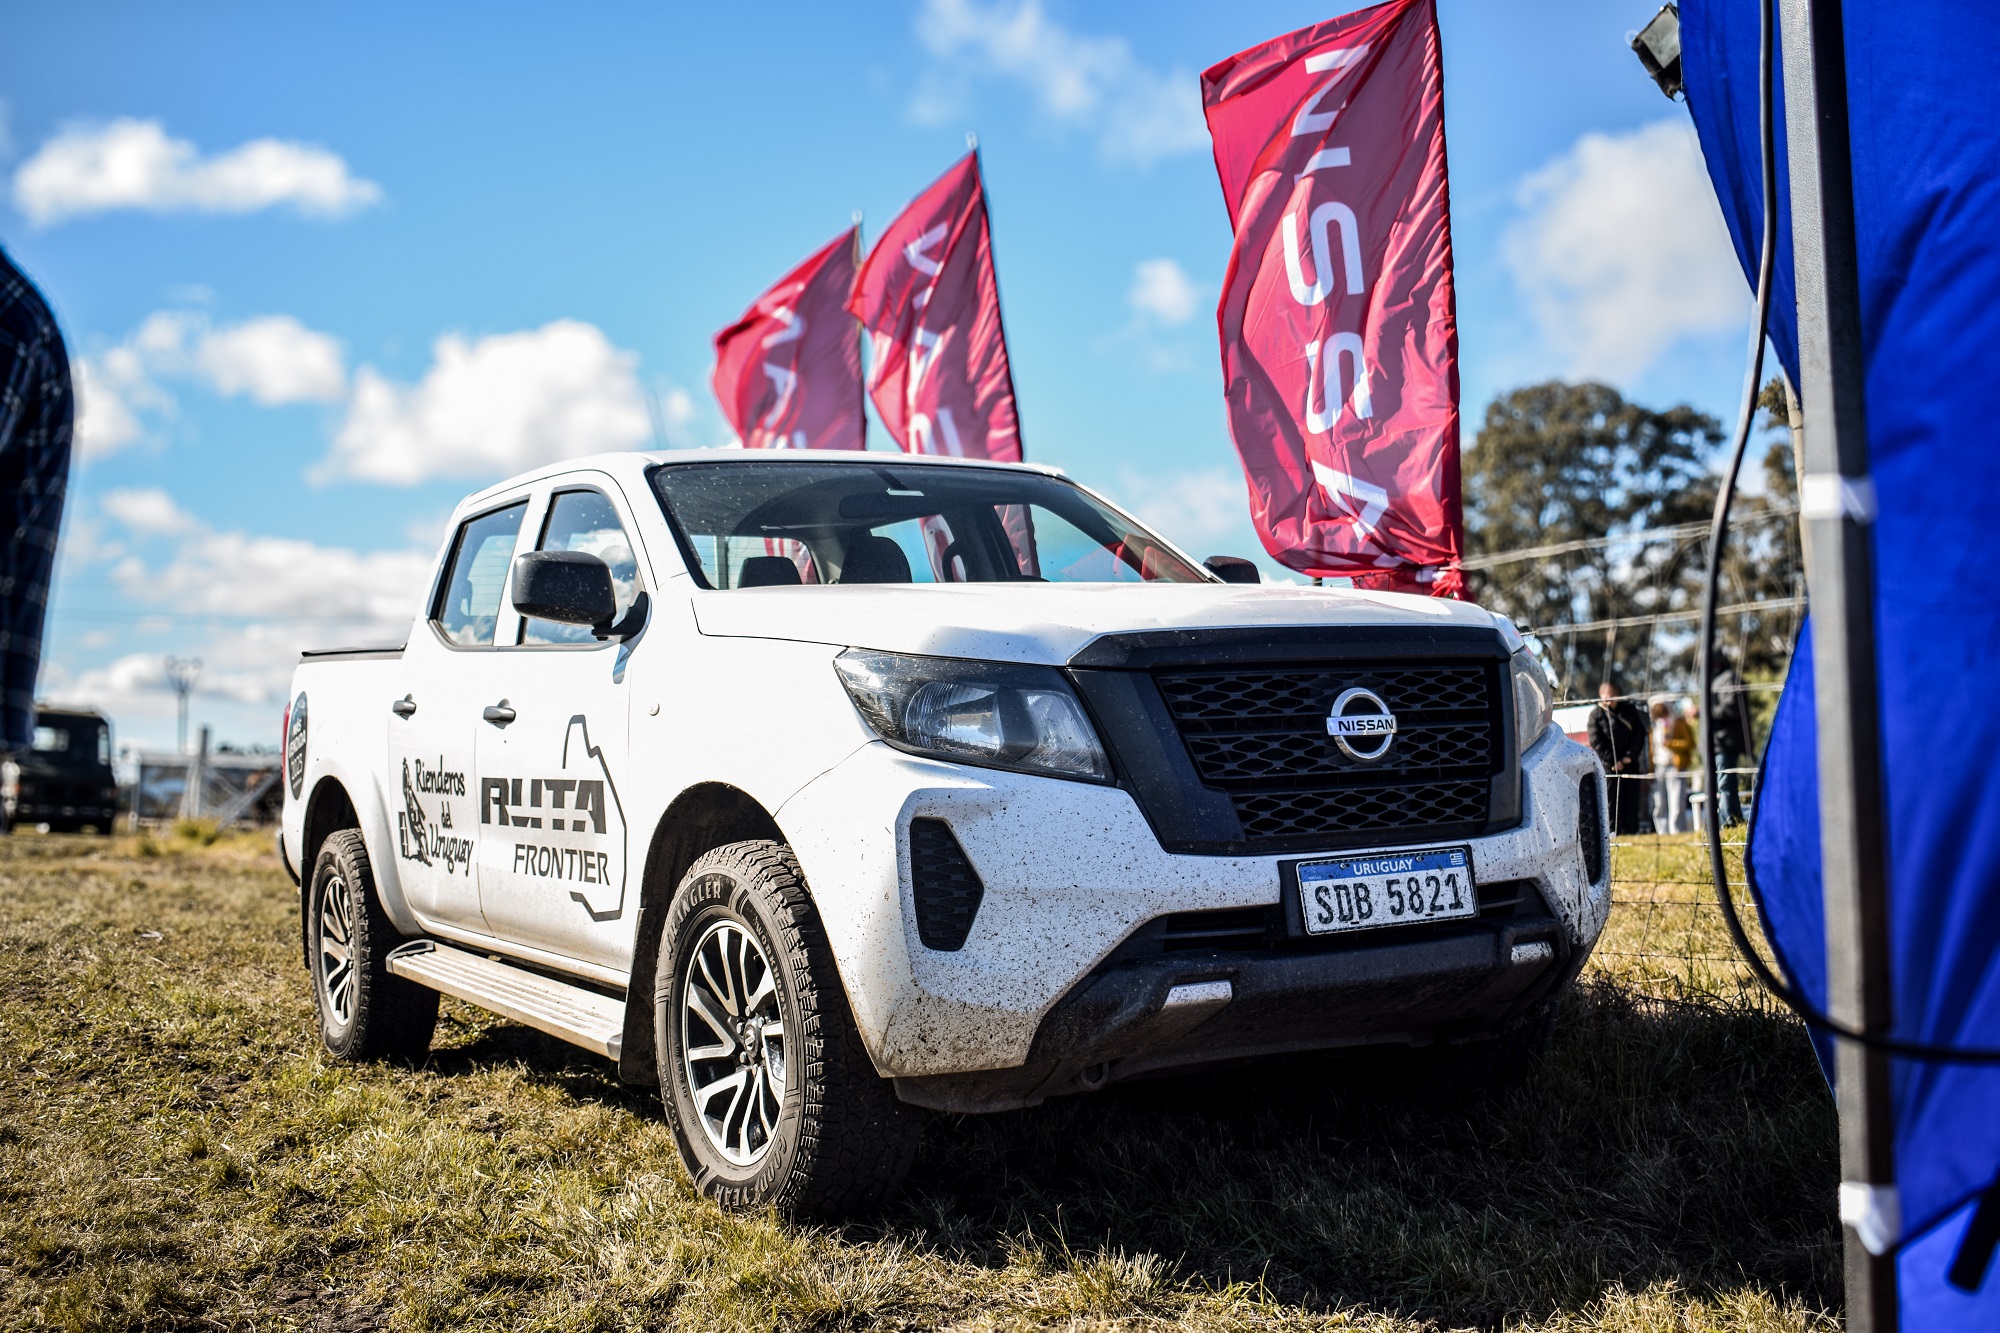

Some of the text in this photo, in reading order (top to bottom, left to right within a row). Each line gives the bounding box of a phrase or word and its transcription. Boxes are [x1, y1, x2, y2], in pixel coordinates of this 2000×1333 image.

[1338, 719, 1394, 732] NISSAN
[415, 755, 465, 796] Rienderos
[441, 801, 452, 829] del
[481, 777, 607, 834] RUTA
[429, 824, 474, 877] Uruguay
[513, 843, 610, 886] FRONTIER
[1353, 859, 1413, 875] URUGUAY
[665, 880, 721, 960] WRANGLER
[1314, 873, 1465, 925] SDB 5821
